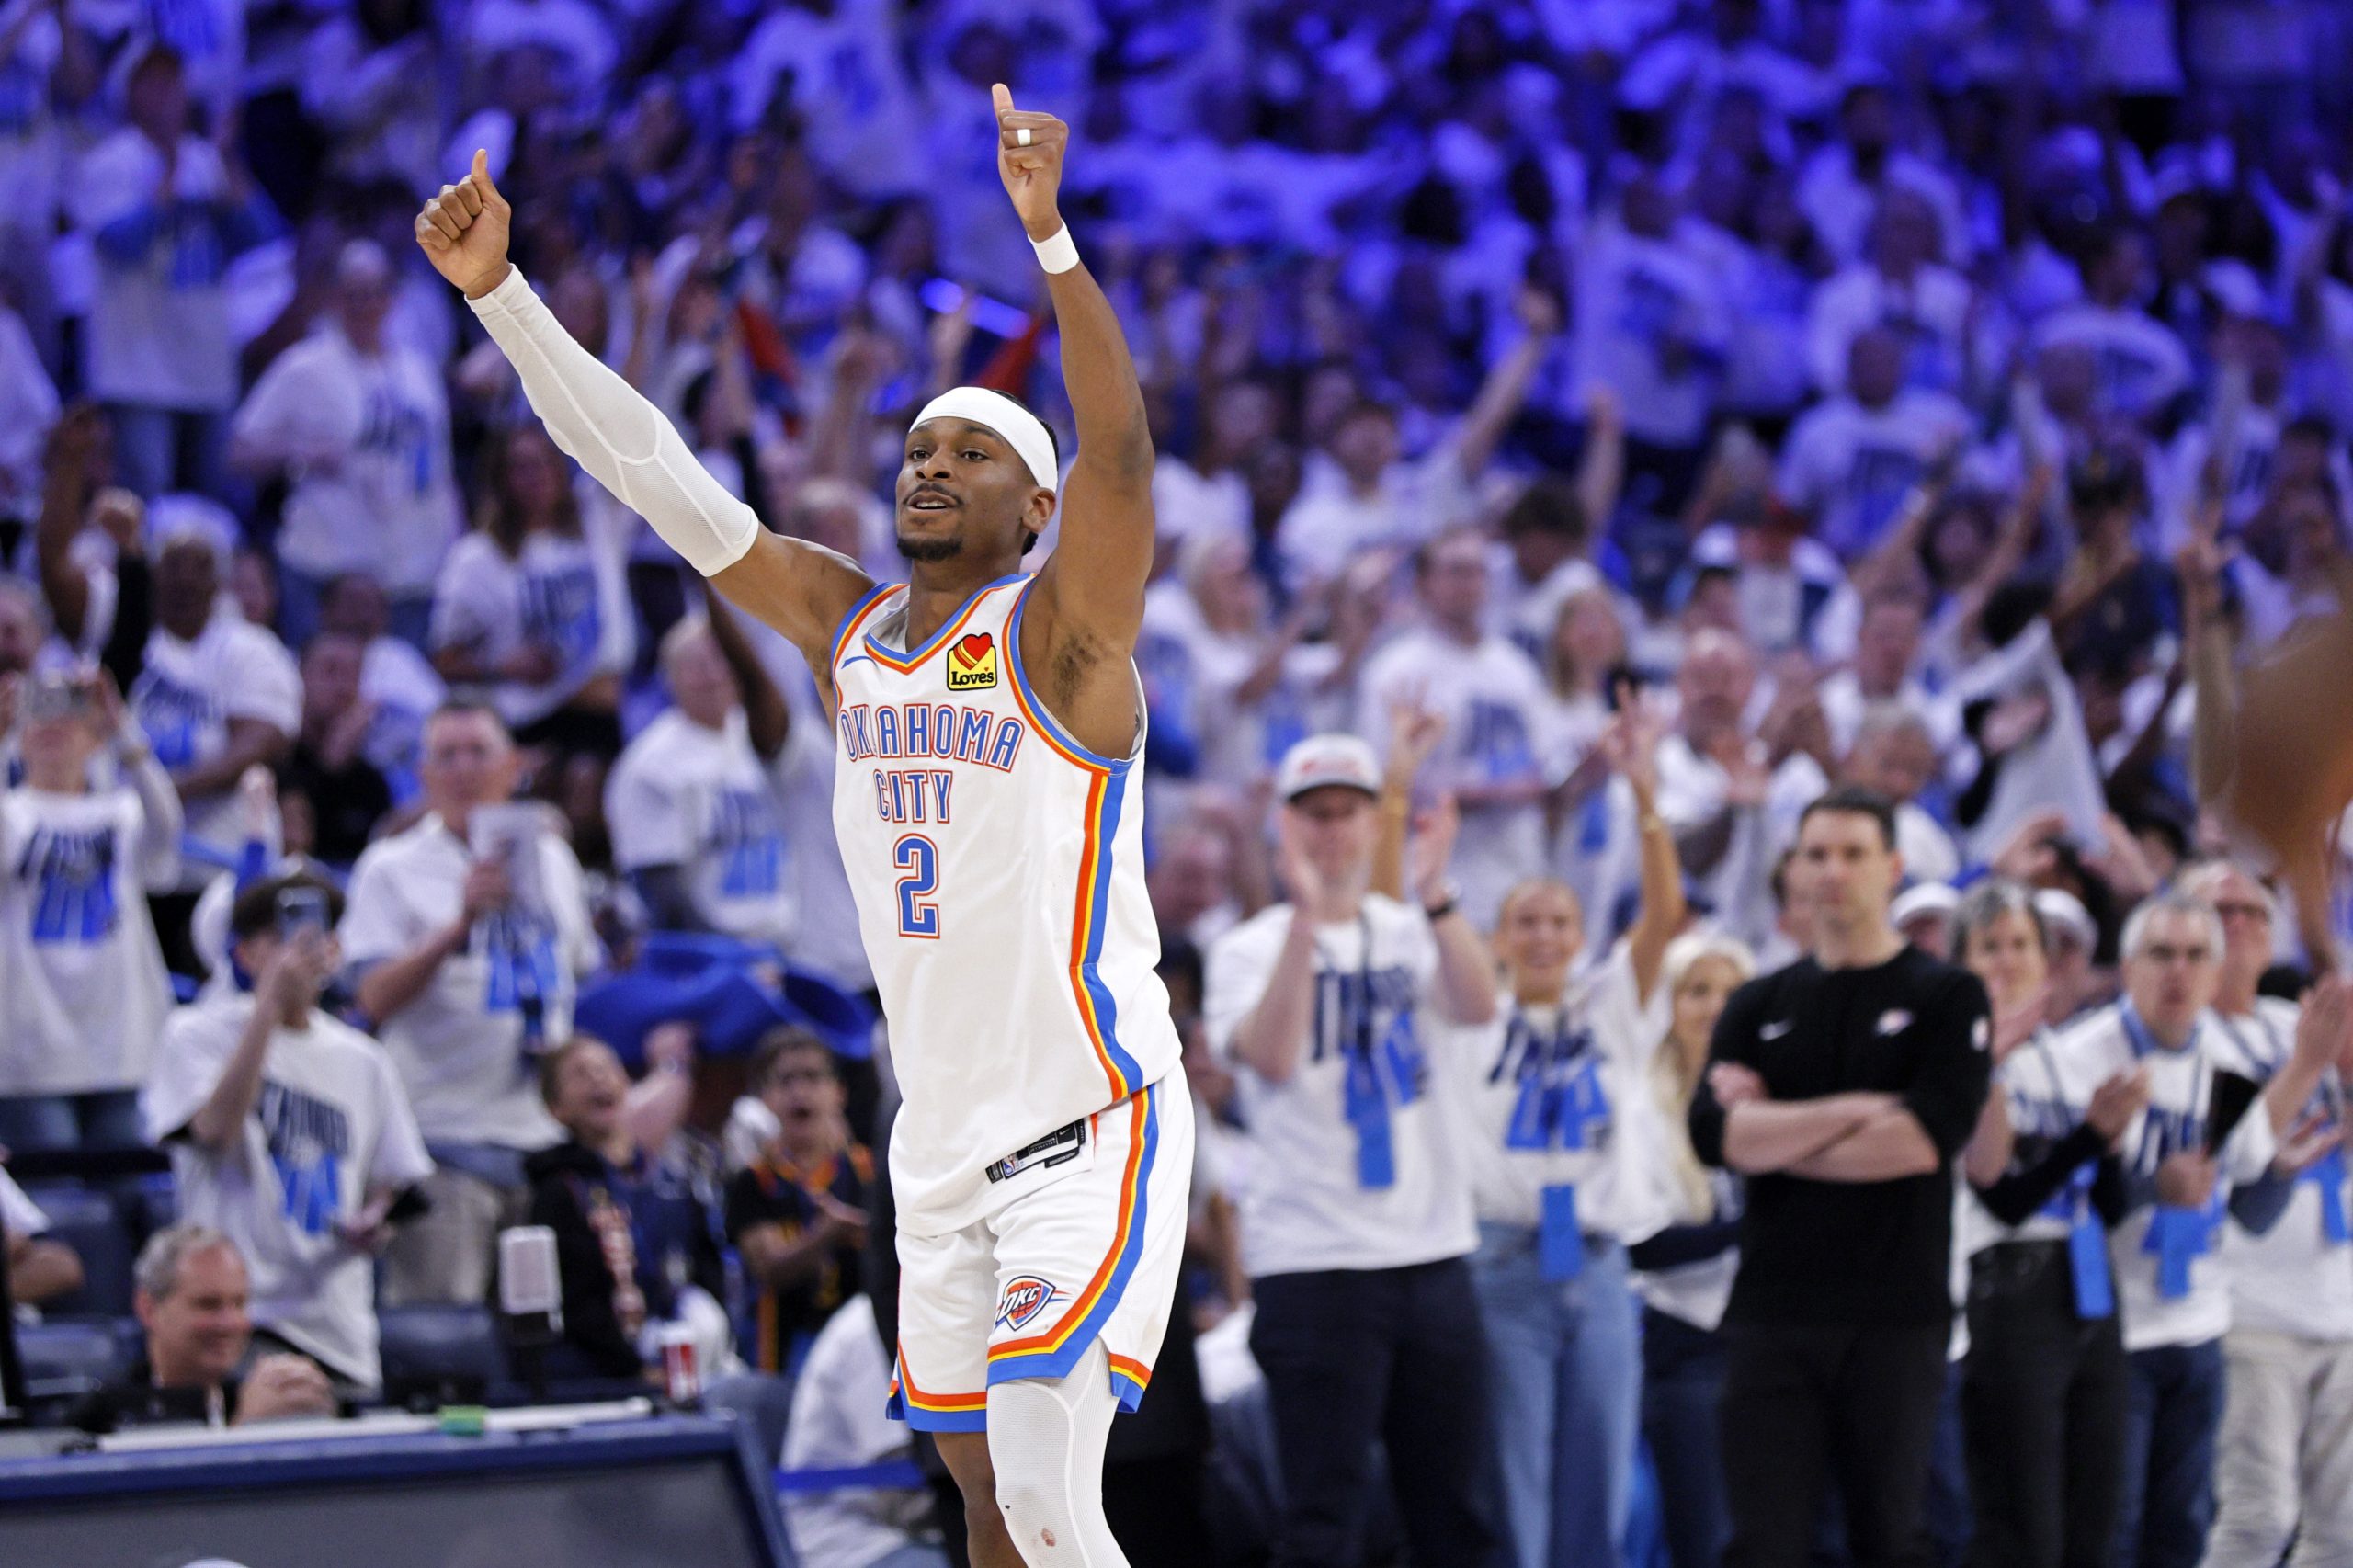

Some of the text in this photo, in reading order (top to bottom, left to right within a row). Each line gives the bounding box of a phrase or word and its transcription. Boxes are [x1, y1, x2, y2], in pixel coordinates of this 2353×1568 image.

[839, 703, 1025, 773] OKAHOMA
[873, 768, 953, 824] CITY
[893, 833, 940, 939] 2
[996, 1286, 1041, 1324] OKC
